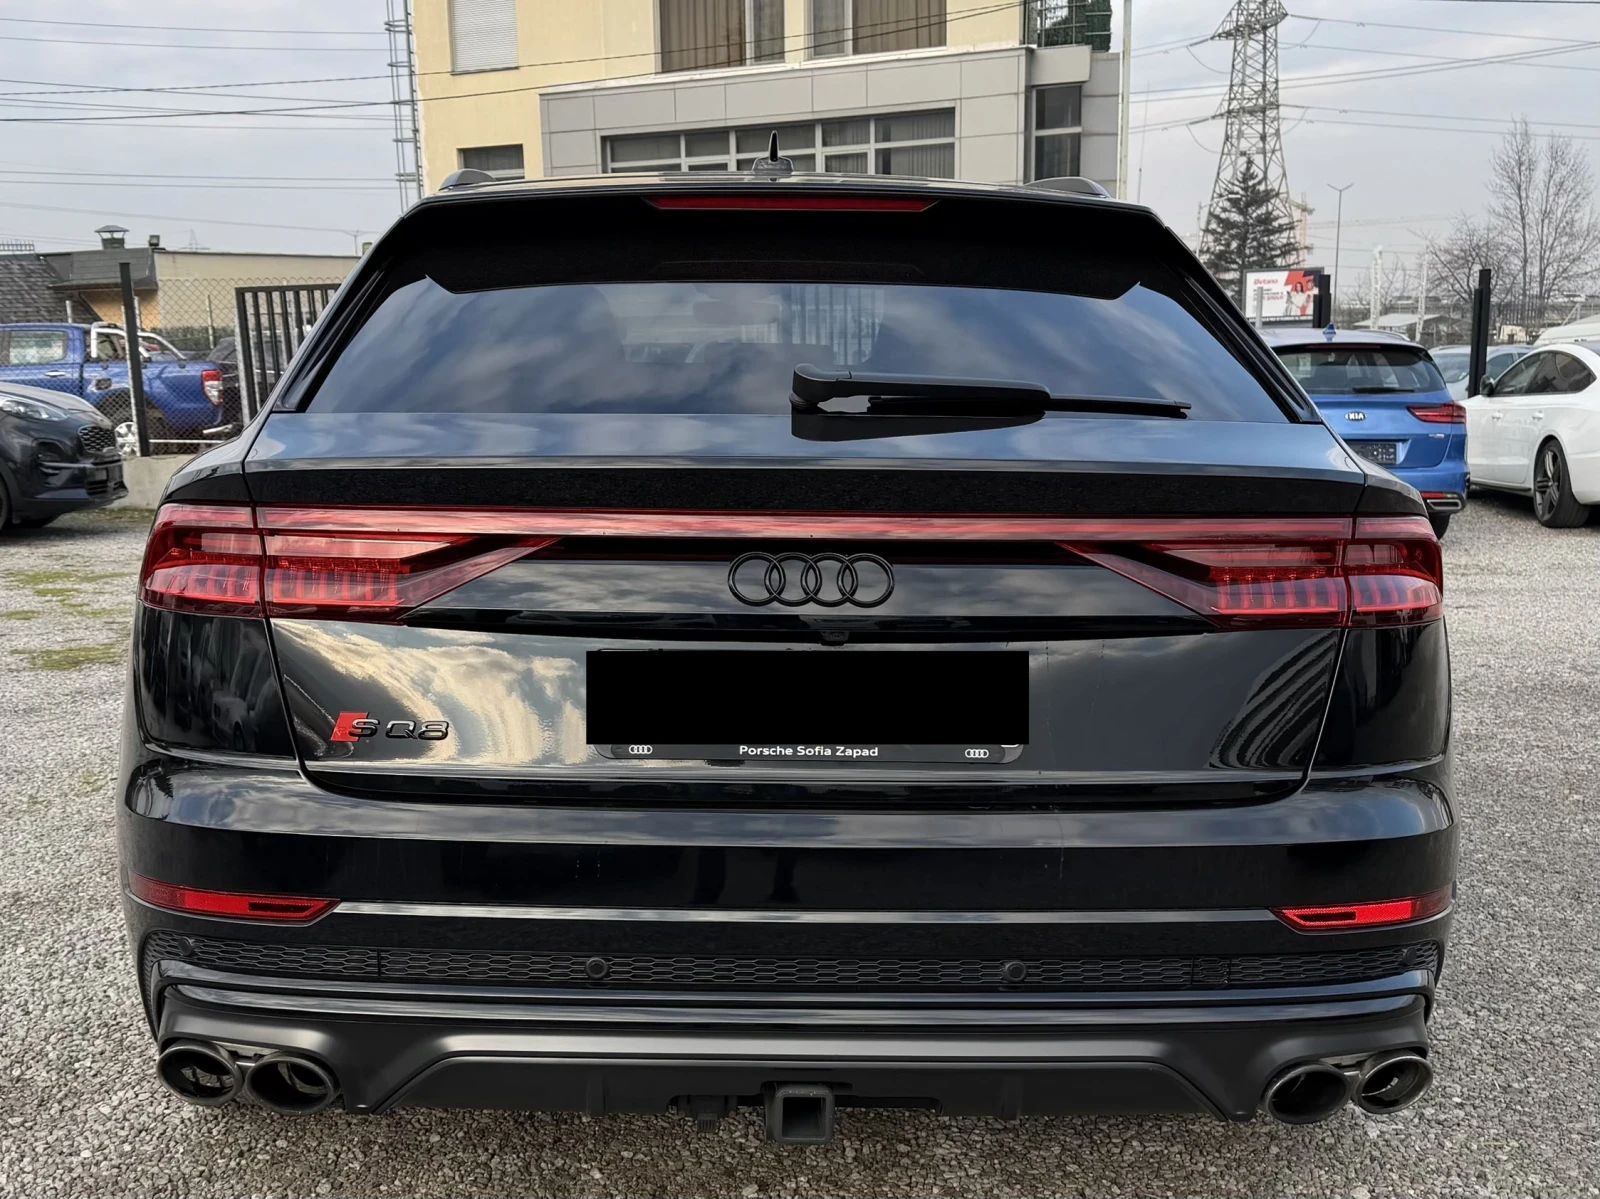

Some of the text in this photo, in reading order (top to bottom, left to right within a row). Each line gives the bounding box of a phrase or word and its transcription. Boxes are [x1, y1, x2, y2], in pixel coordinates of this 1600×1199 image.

[738, 745, 879, 758] Porsche Sofia Zapad
